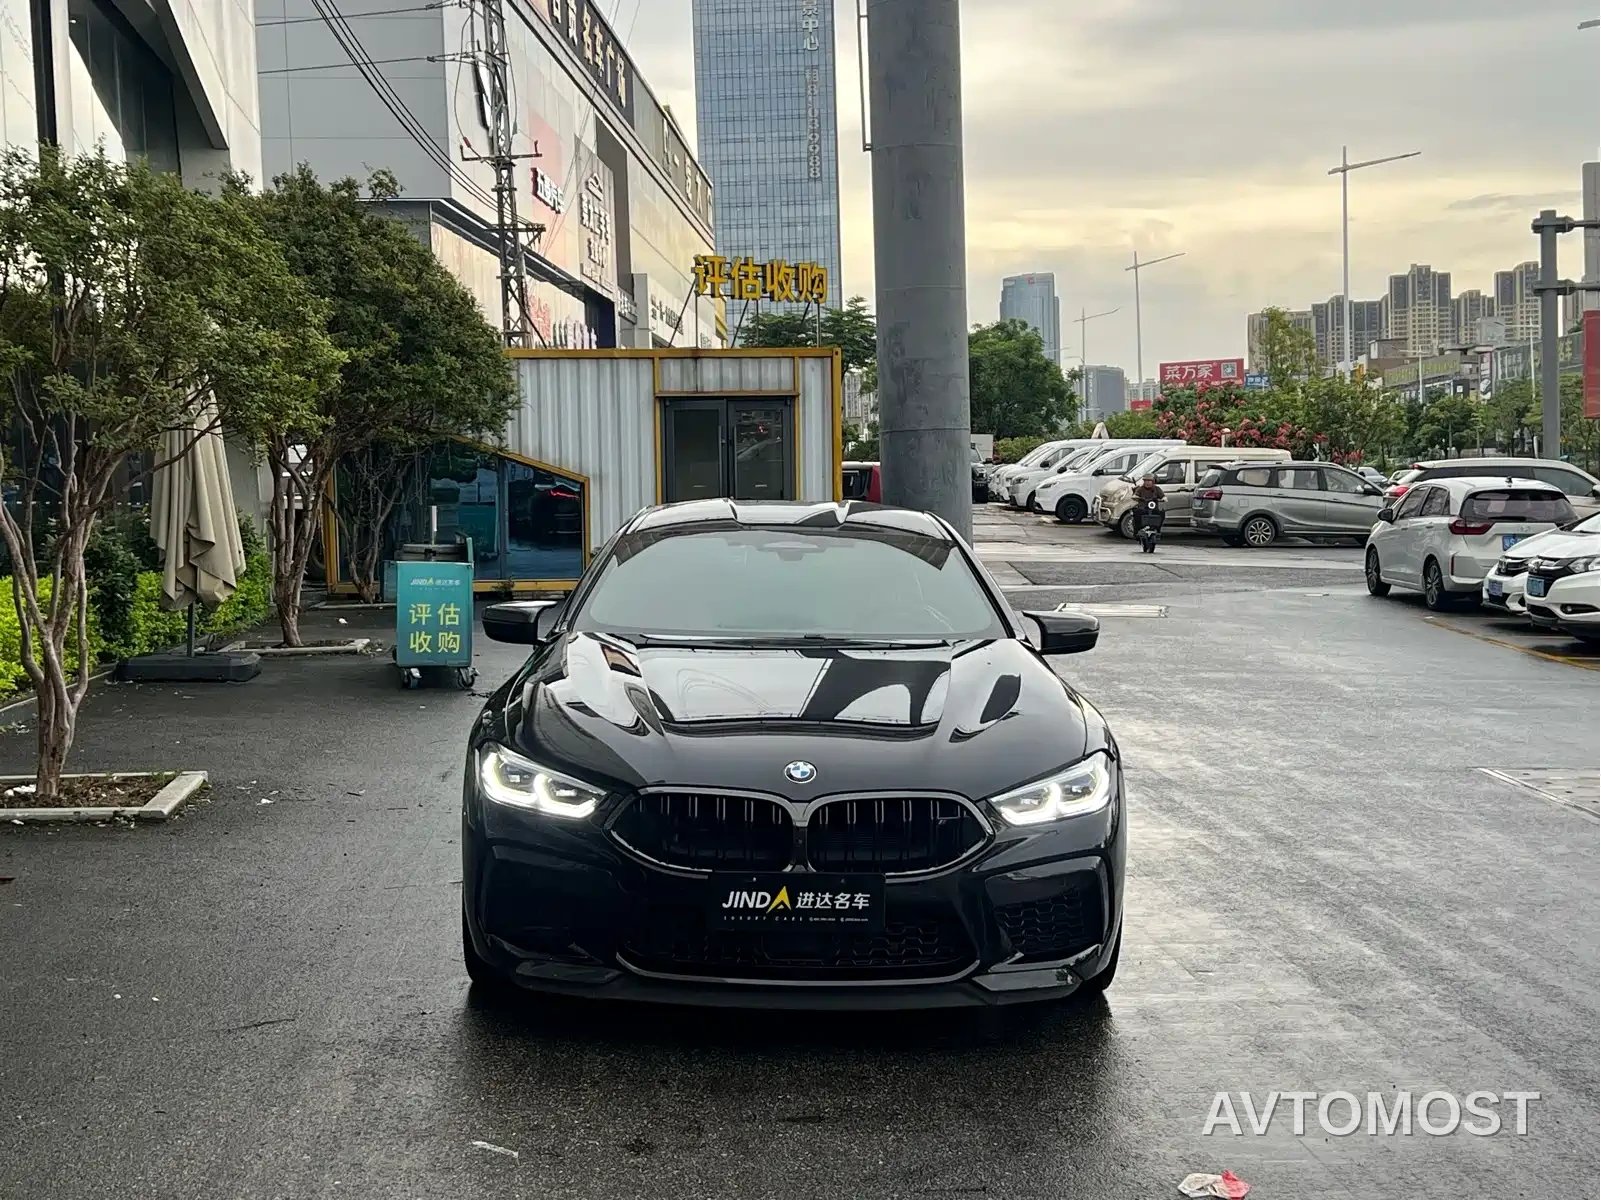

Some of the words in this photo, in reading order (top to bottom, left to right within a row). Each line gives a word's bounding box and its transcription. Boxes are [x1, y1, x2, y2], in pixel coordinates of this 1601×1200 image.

[692, 254, 828, 304] 评估收购
[1164, 363, 1213, 380] 菜万家
[409, 603, 461, 626] 评估
[409, 631, 461, 654] 收购
[722, 885, 792, 914] JINDA
[795, 891, 871, 910] 进达名车
